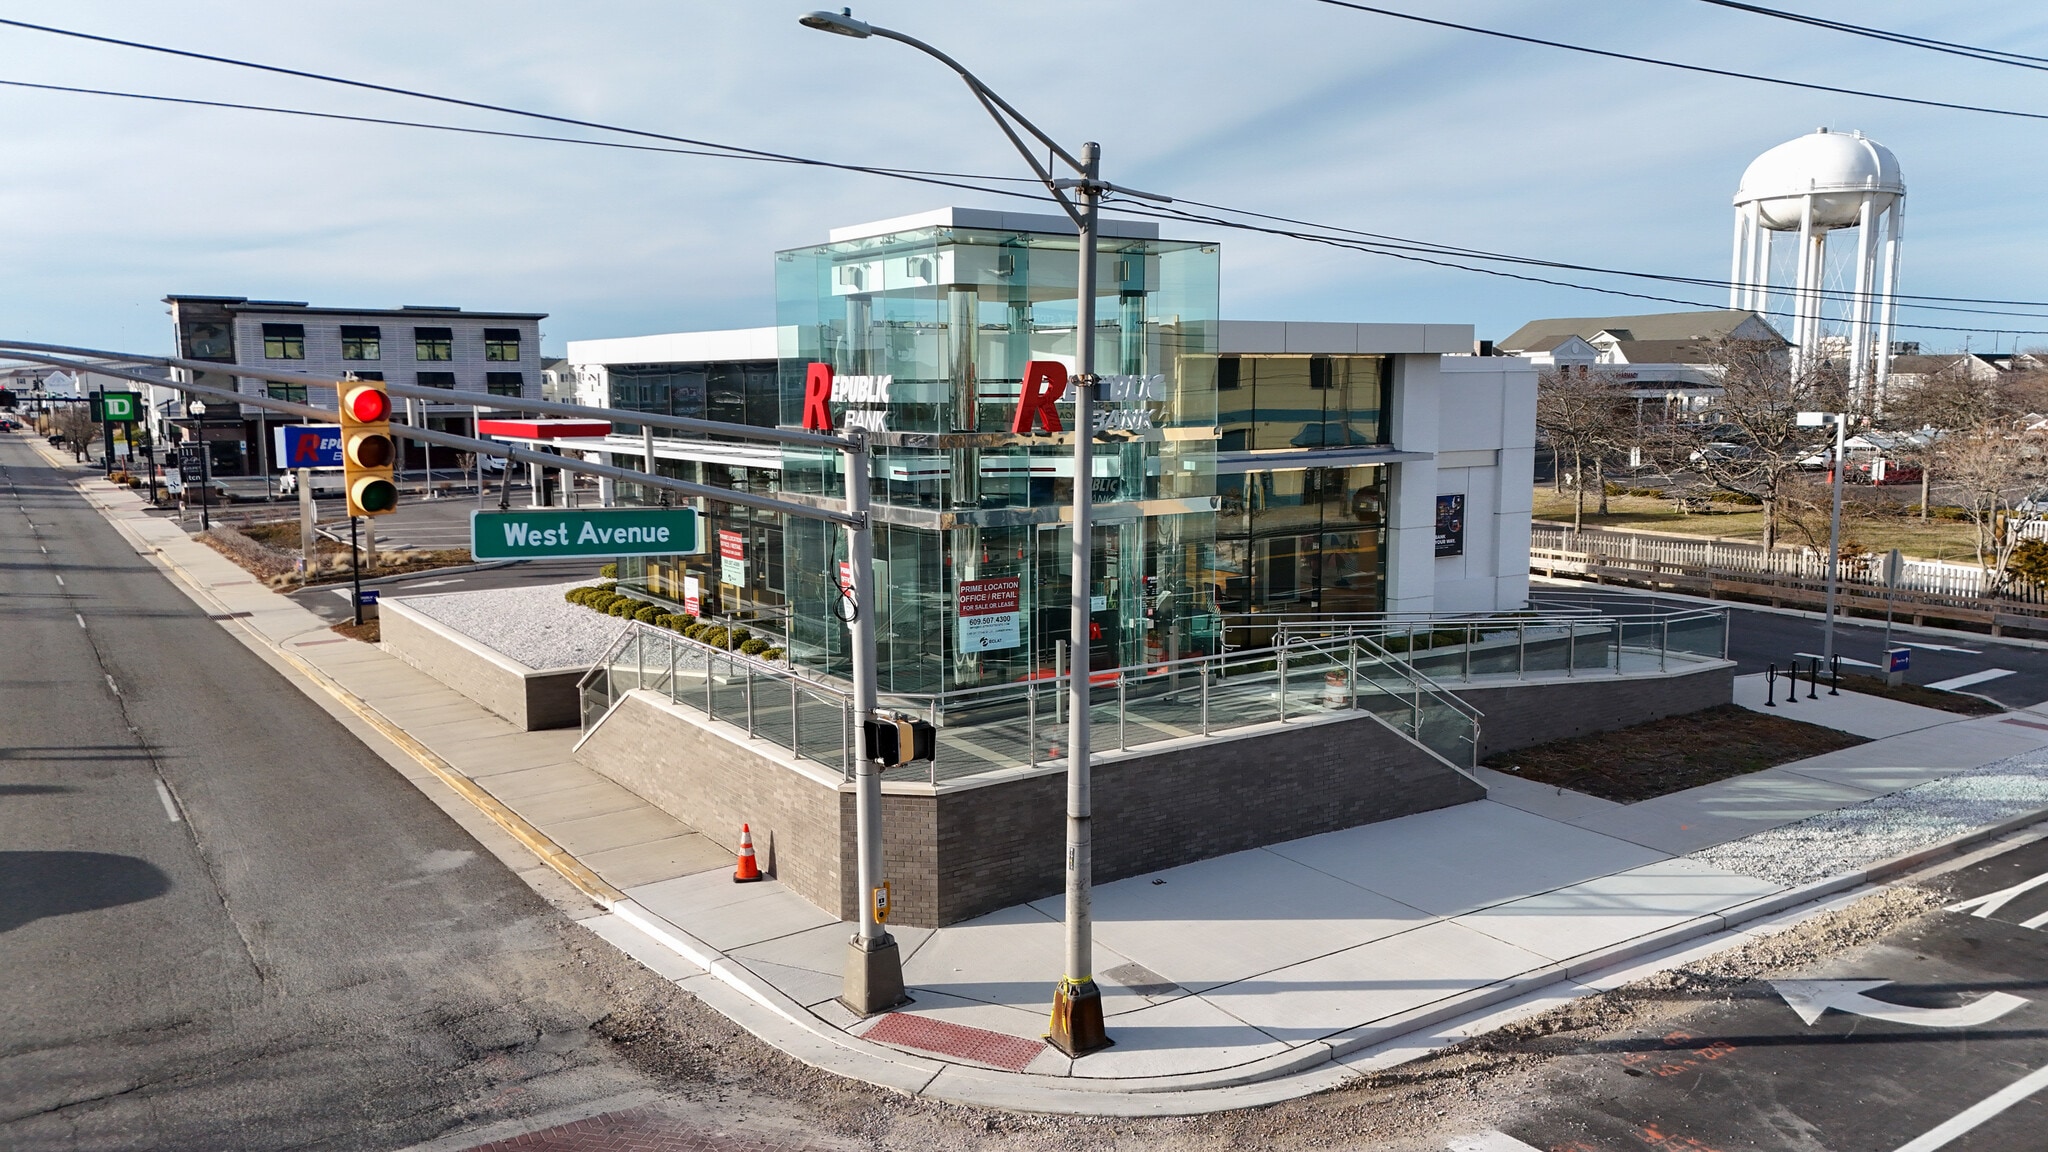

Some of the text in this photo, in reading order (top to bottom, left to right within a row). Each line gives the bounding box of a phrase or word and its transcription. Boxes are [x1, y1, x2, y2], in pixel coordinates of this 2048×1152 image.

[802, 362, 894, 430] REPUBLIC
[105, 399, 131, 416] TD
[844, 410, 888, 433] BANK
[503, 521, 670, 547] West Avenue
[960, 581, 1019, 593] PRIME LOCATION
[960, 594, 987, 603] OFFICE
[991, 591, 1017, 600] RETAIL
[969, 615, 1011, 626] 609.507.4300
